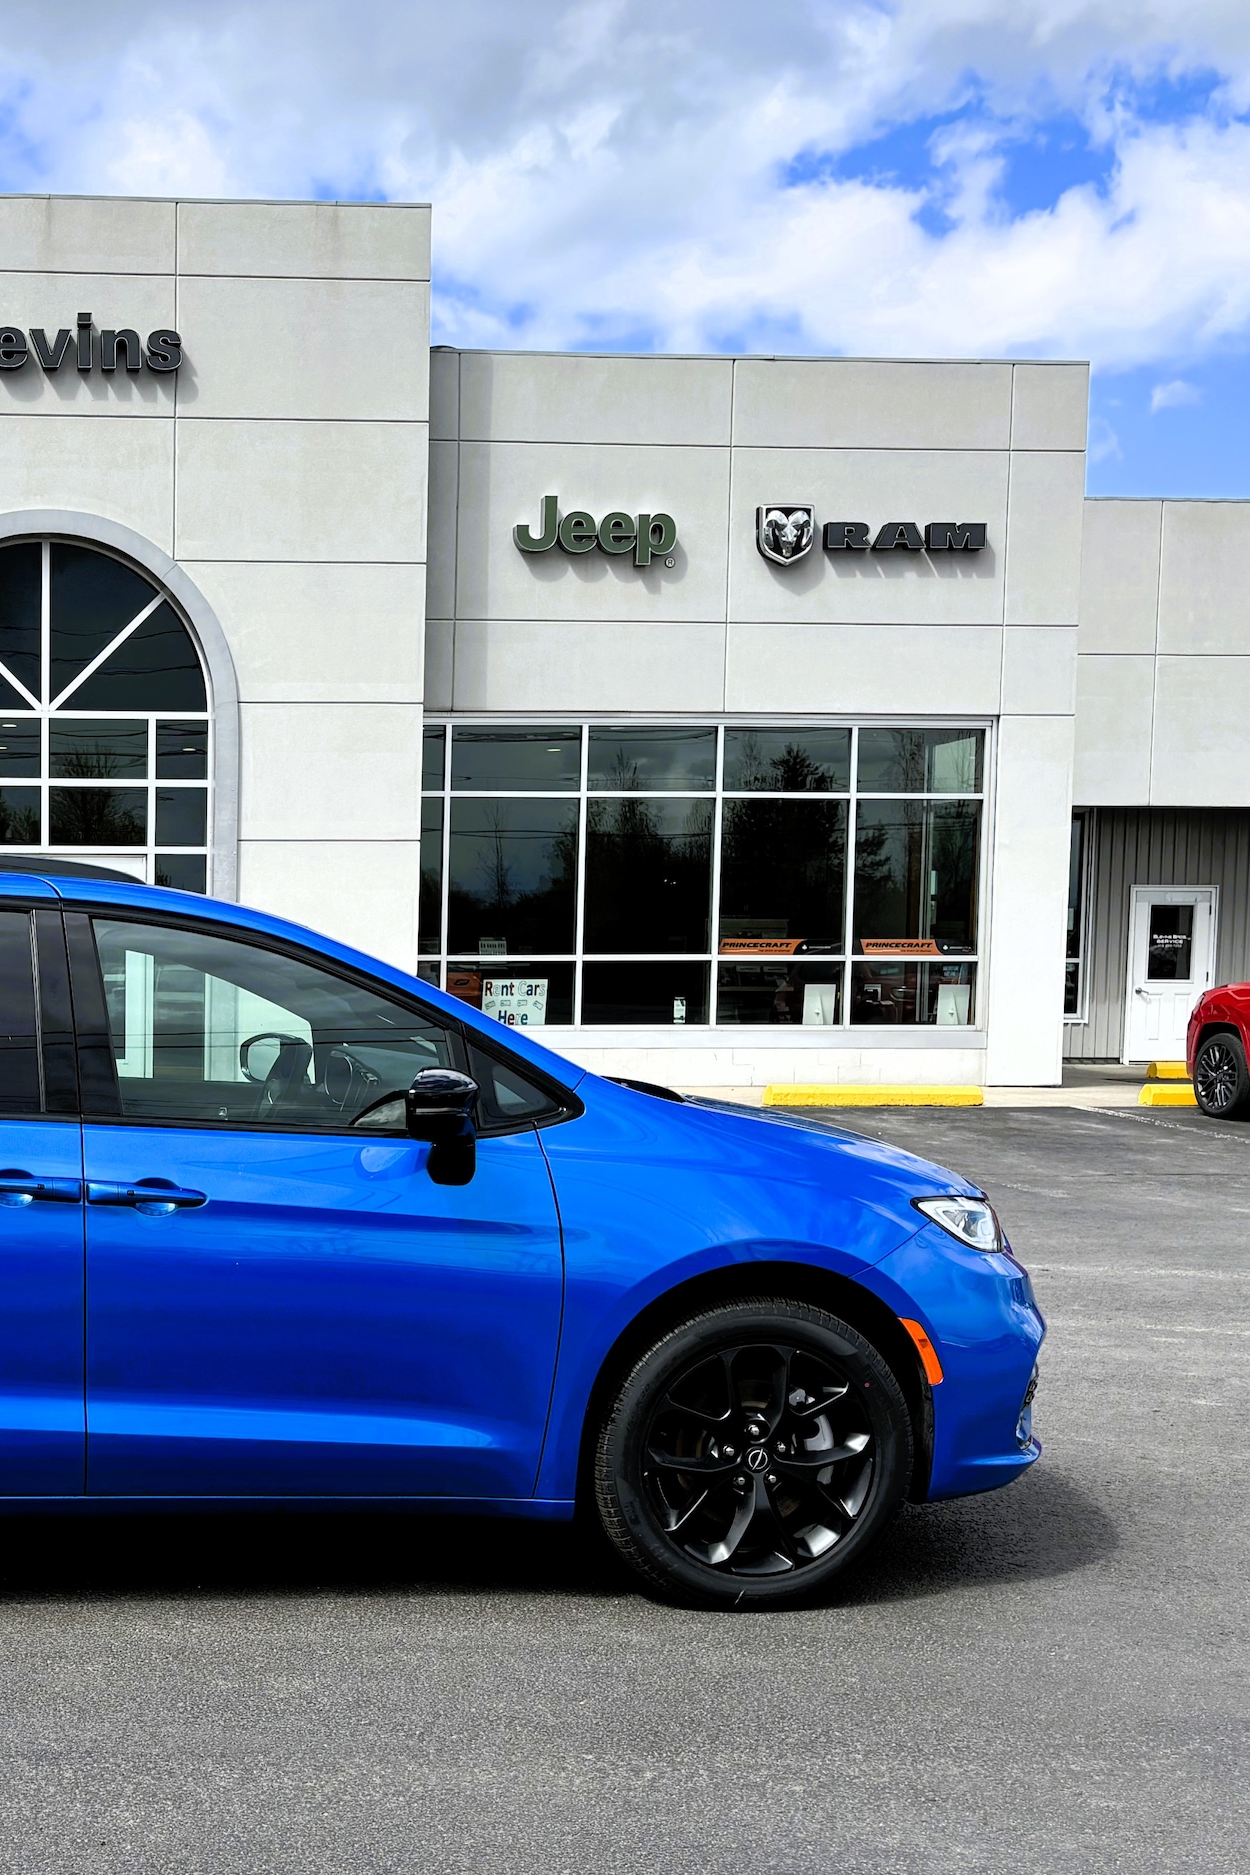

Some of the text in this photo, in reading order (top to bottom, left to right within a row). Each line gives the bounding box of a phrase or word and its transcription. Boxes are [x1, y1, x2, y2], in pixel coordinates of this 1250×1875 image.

[513, 495, 678, 567] Jeep
[822, 521, 989, 550] RAM
[484, 980, 546, 997] Rent Cars
[498, 1010, 528, 1025] Here
